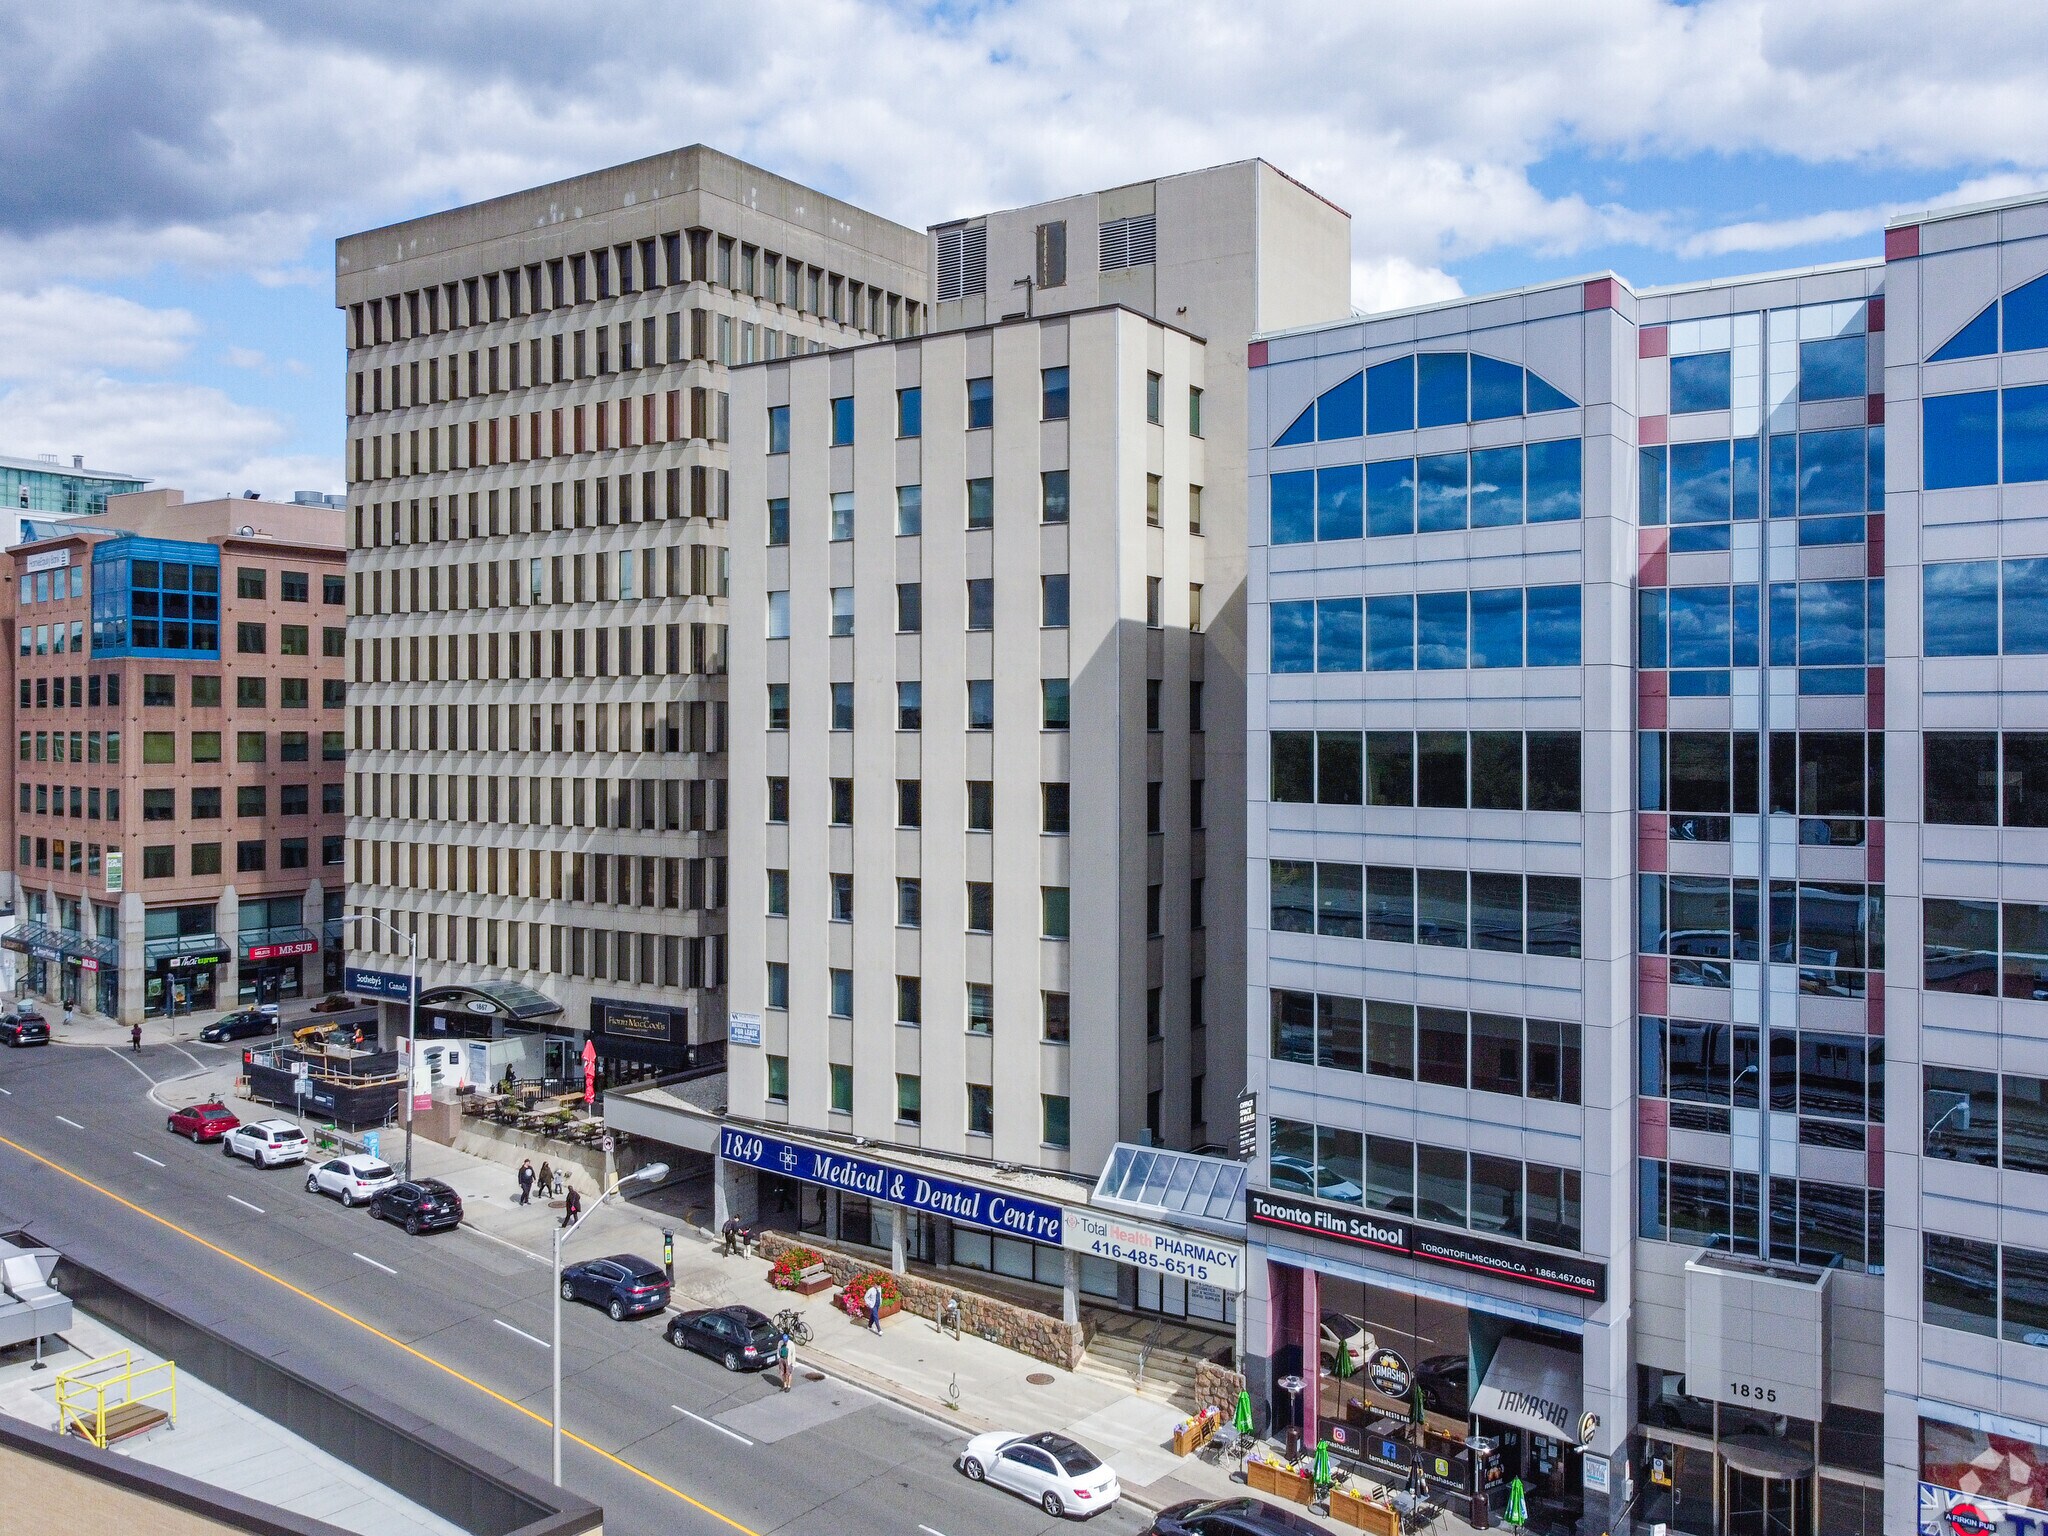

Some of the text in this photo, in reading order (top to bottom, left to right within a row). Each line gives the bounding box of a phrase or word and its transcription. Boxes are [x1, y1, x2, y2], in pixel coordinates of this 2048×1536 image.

[279, 942, 313, 955] MR.SUB
[356, 973, 408, 992] Sotheby's Canada
[724, 1133, 1060, 1238] 1849 Medical & Dental Centre
[1253, 1197, 1403, 1245] Toronto Film School
[1080, 1218, 1238, 1268] Total Health PHARMACY
[1091, 1240, 1208, 1280] 416-485-6515
[1421, 1243, 1596, 1287] TORONTOFILMSCHOOL.CA 1.866.467.0661
[1372, 1364, 1407, 1385] TAMASHA
[1730, 1382, 1777, 1403] 1835
[1497, 1389, 1569, 1429] TAMASHA
[1325, 1440, 1360, 1455] mashasocial
[1423, 1472, 1464, 1489] amashasocial
[1952, 1514, 1978, 1527] FIRKIN
[1978, 1521, 1995, 1531] PUB
